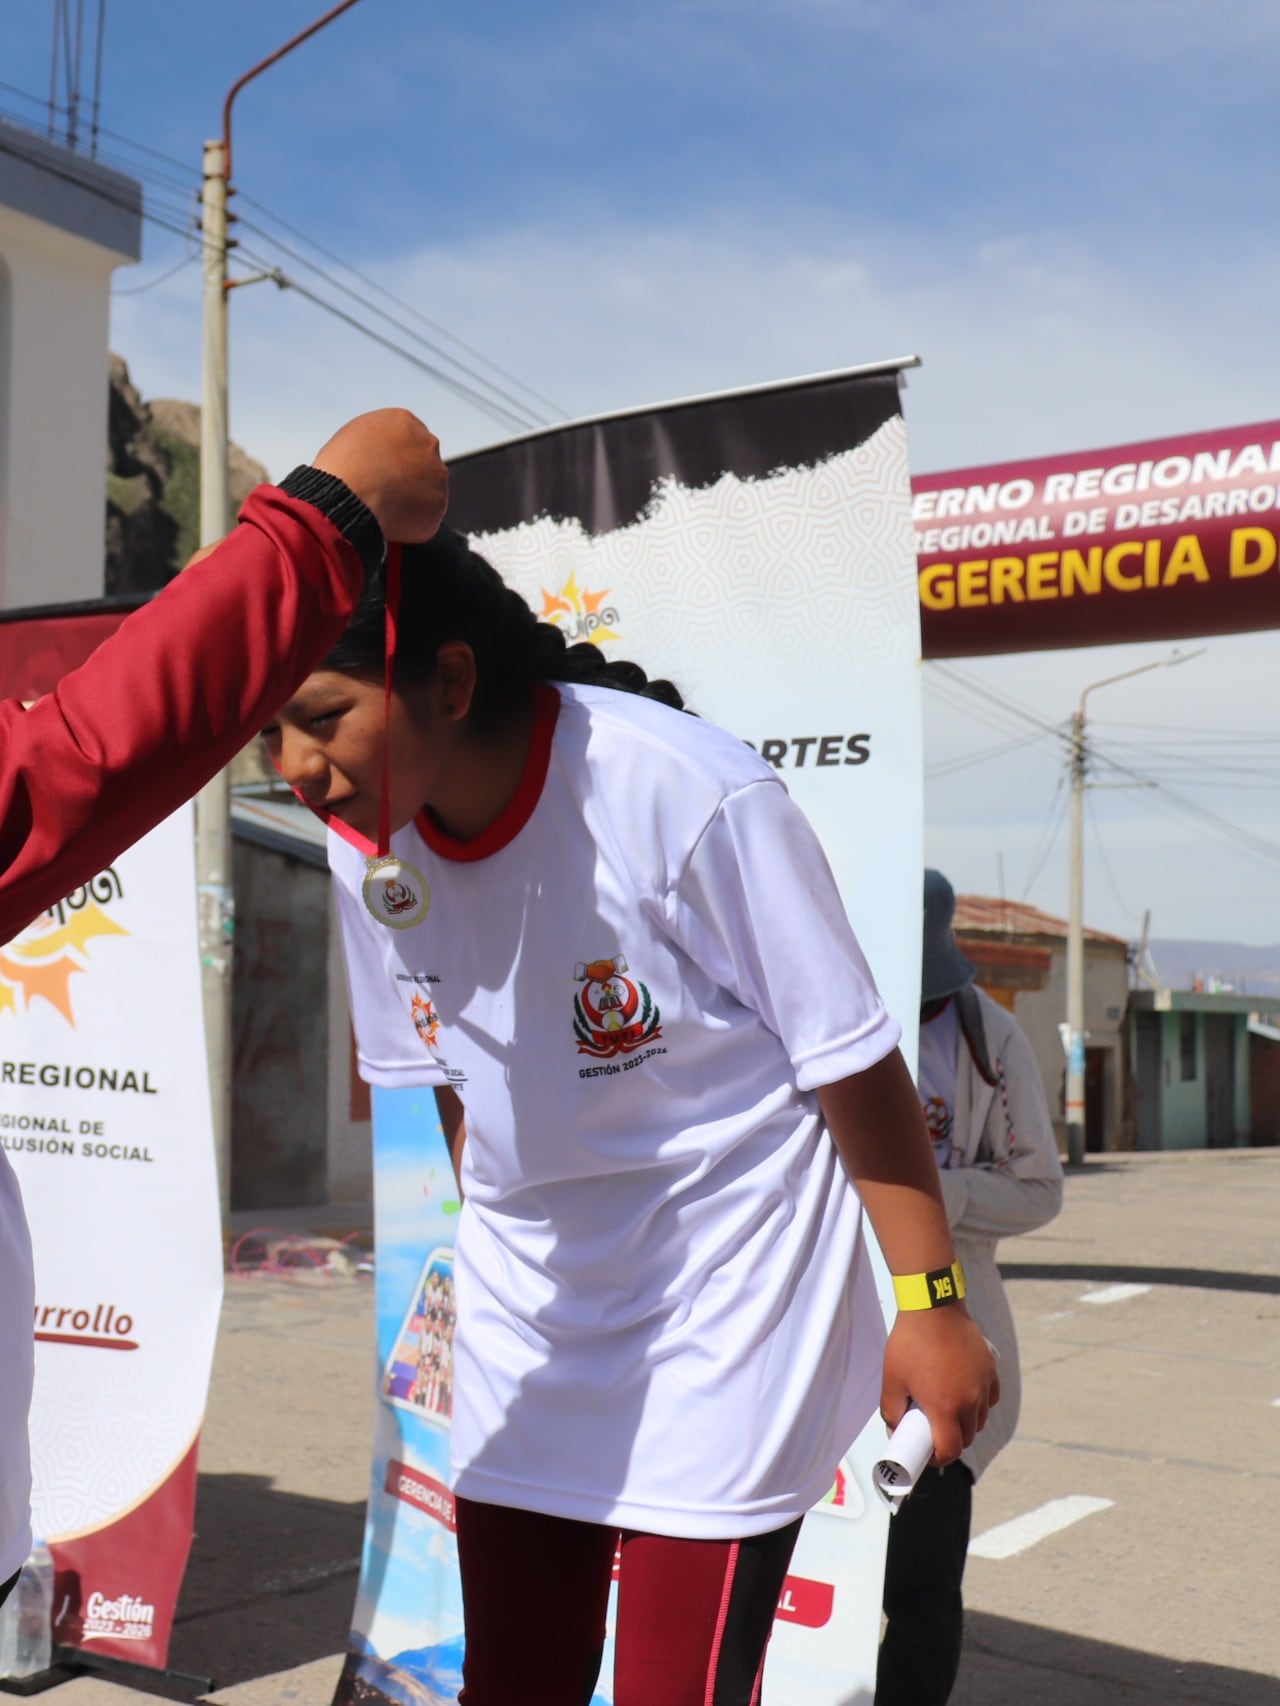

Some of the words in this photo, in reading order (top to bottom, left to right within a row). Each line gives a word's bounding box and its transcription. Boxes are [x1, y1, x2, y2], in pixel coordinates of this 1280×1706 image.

[1062, 508, 1108, 538] DE
[1115, 484, 1280, 531] DESARRO
[919, 534, 1210, 611] GERENCIA
[742, 733, 872, 769] RTES
[2, 1062, 158, 1095] REGIONAL
[579, 1064, 620, 1079] GESTIÓN
[79, 1120, 104, 1136] DE
[81, 1143, 155, 1163] SOCIAL
[86, 1591, 156, 1625] Gestión
